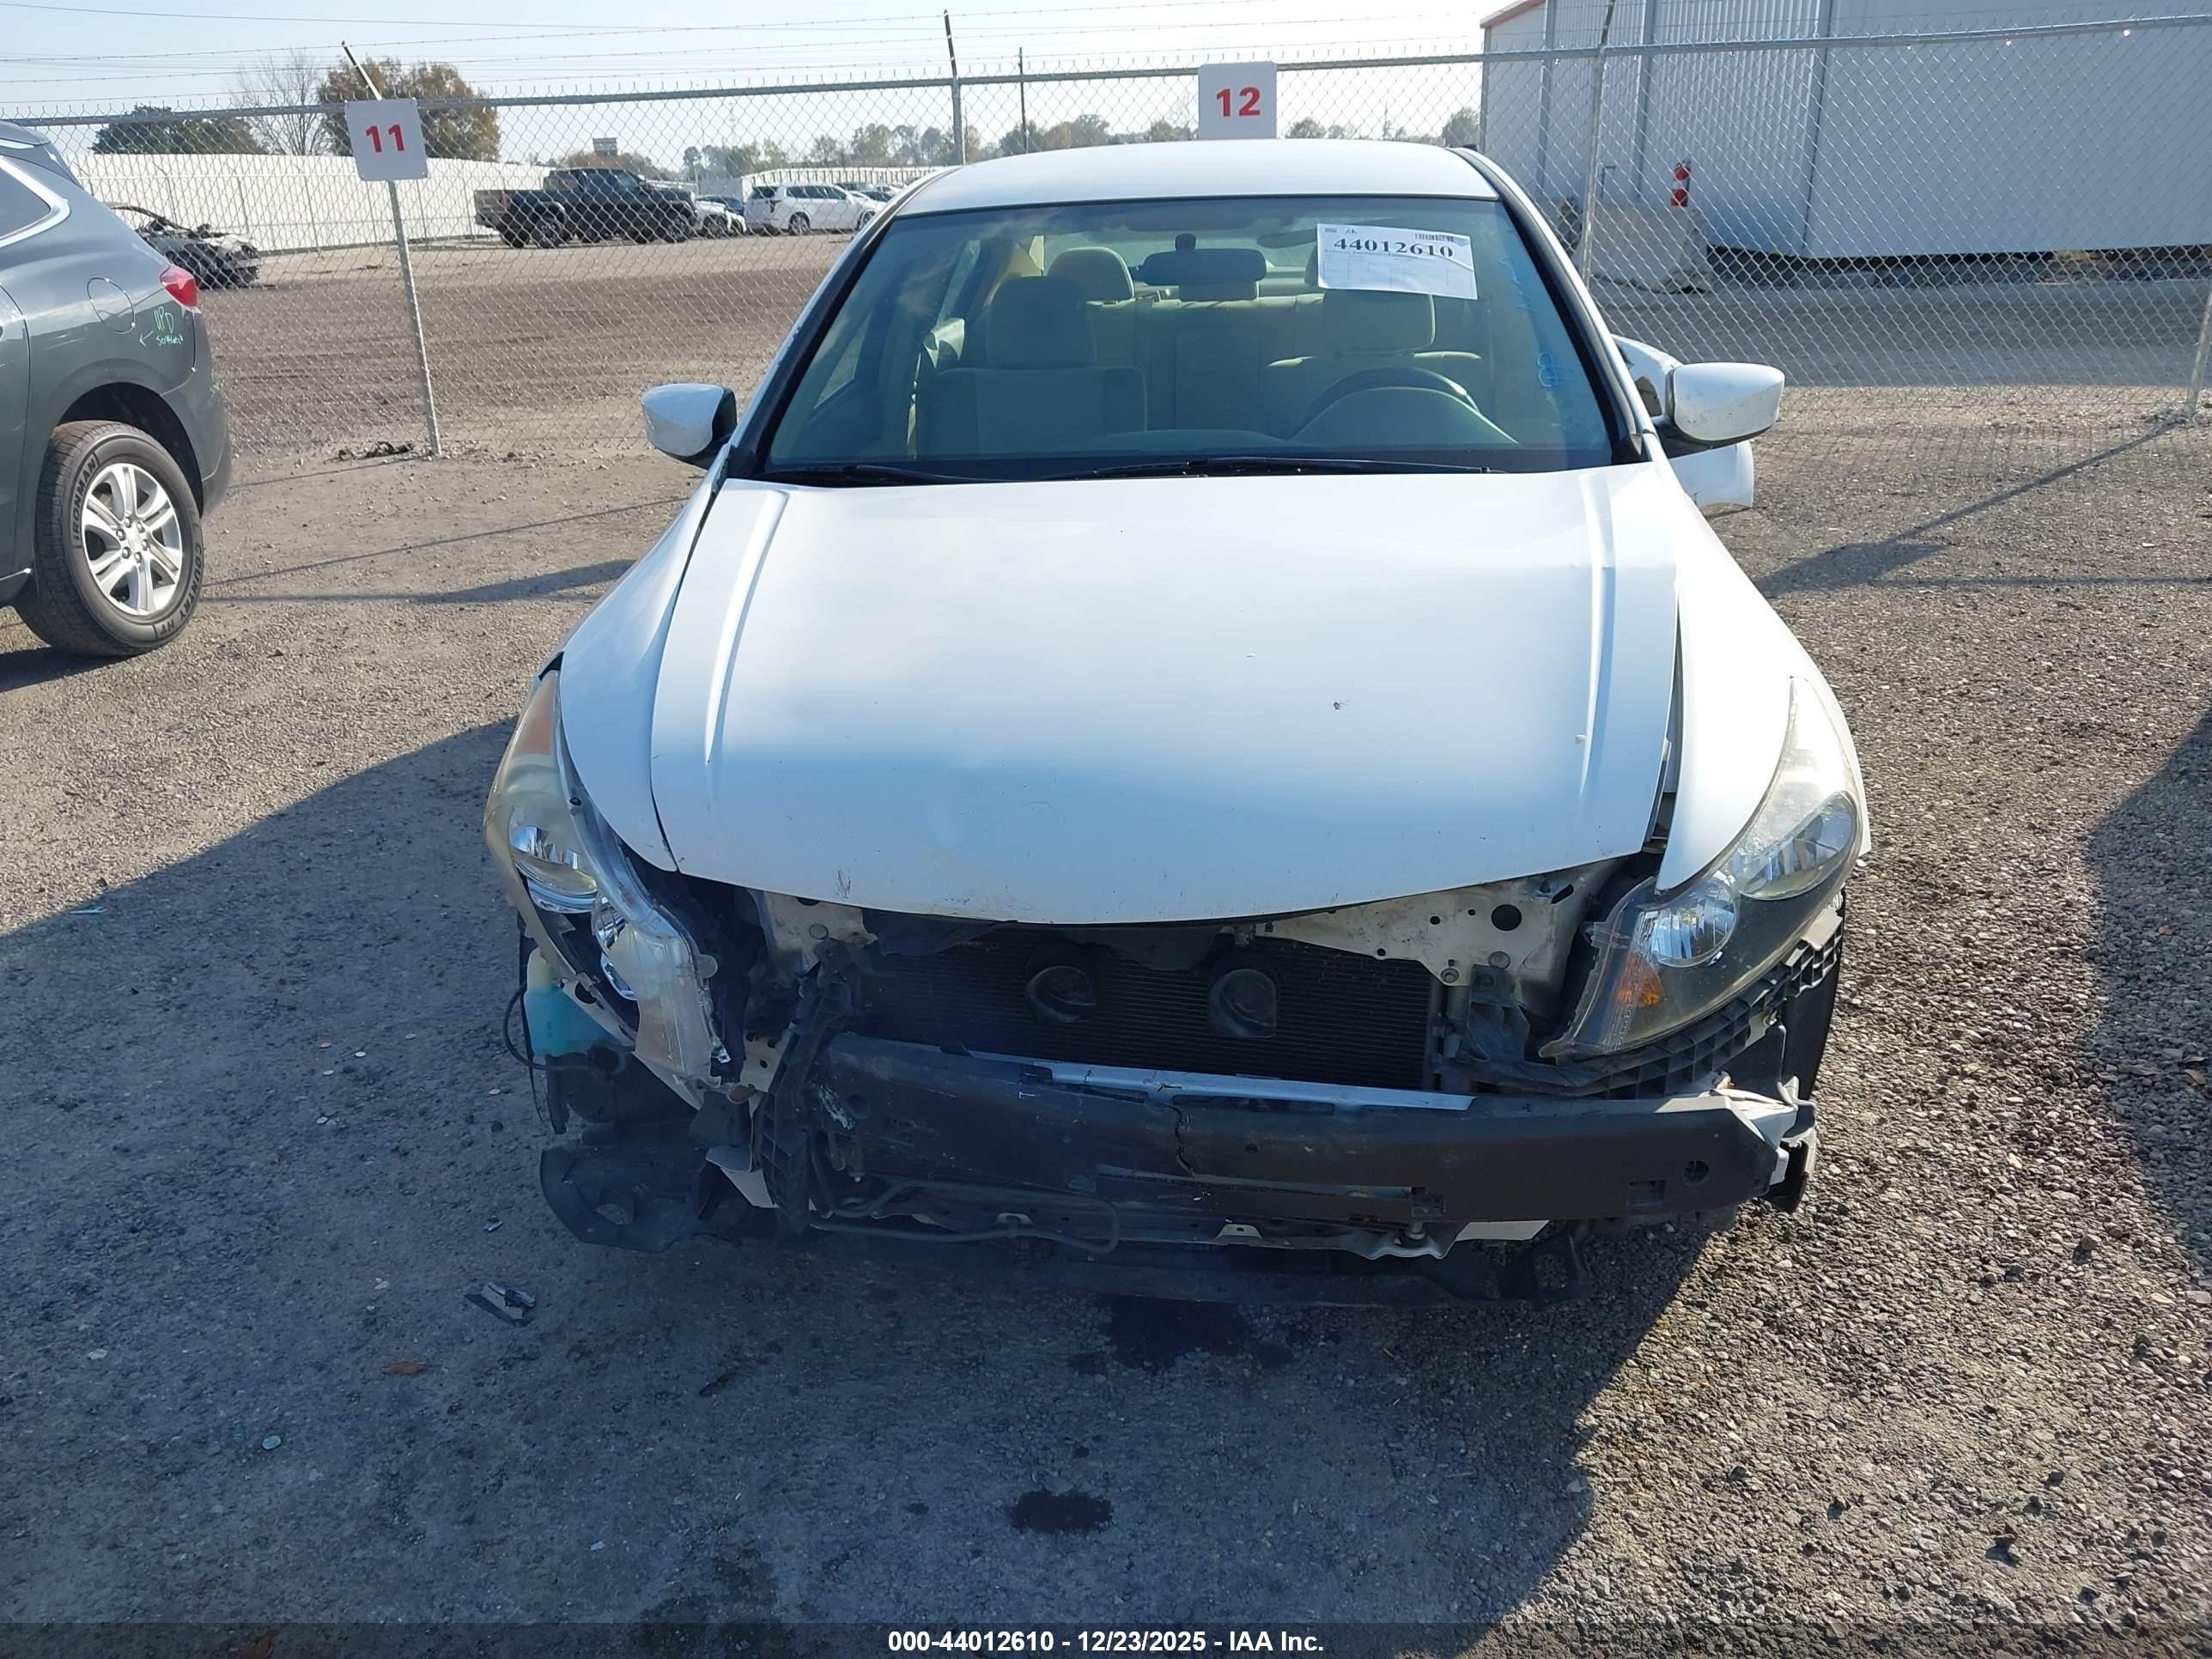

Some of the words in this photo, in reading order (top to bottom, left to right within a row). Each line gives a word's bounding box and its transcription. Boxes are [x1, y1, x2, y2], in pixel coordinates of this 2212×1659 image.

[1216, 87, 1261, 117] 12
[366, 125, 404, 153] 11
[1334, 238, 1454, 258] 44012610
[71, 457, 96, 541] IRONMAN
[180, 543, 203, 621] COUNTRY
[160, 619, 176, 636] HT
